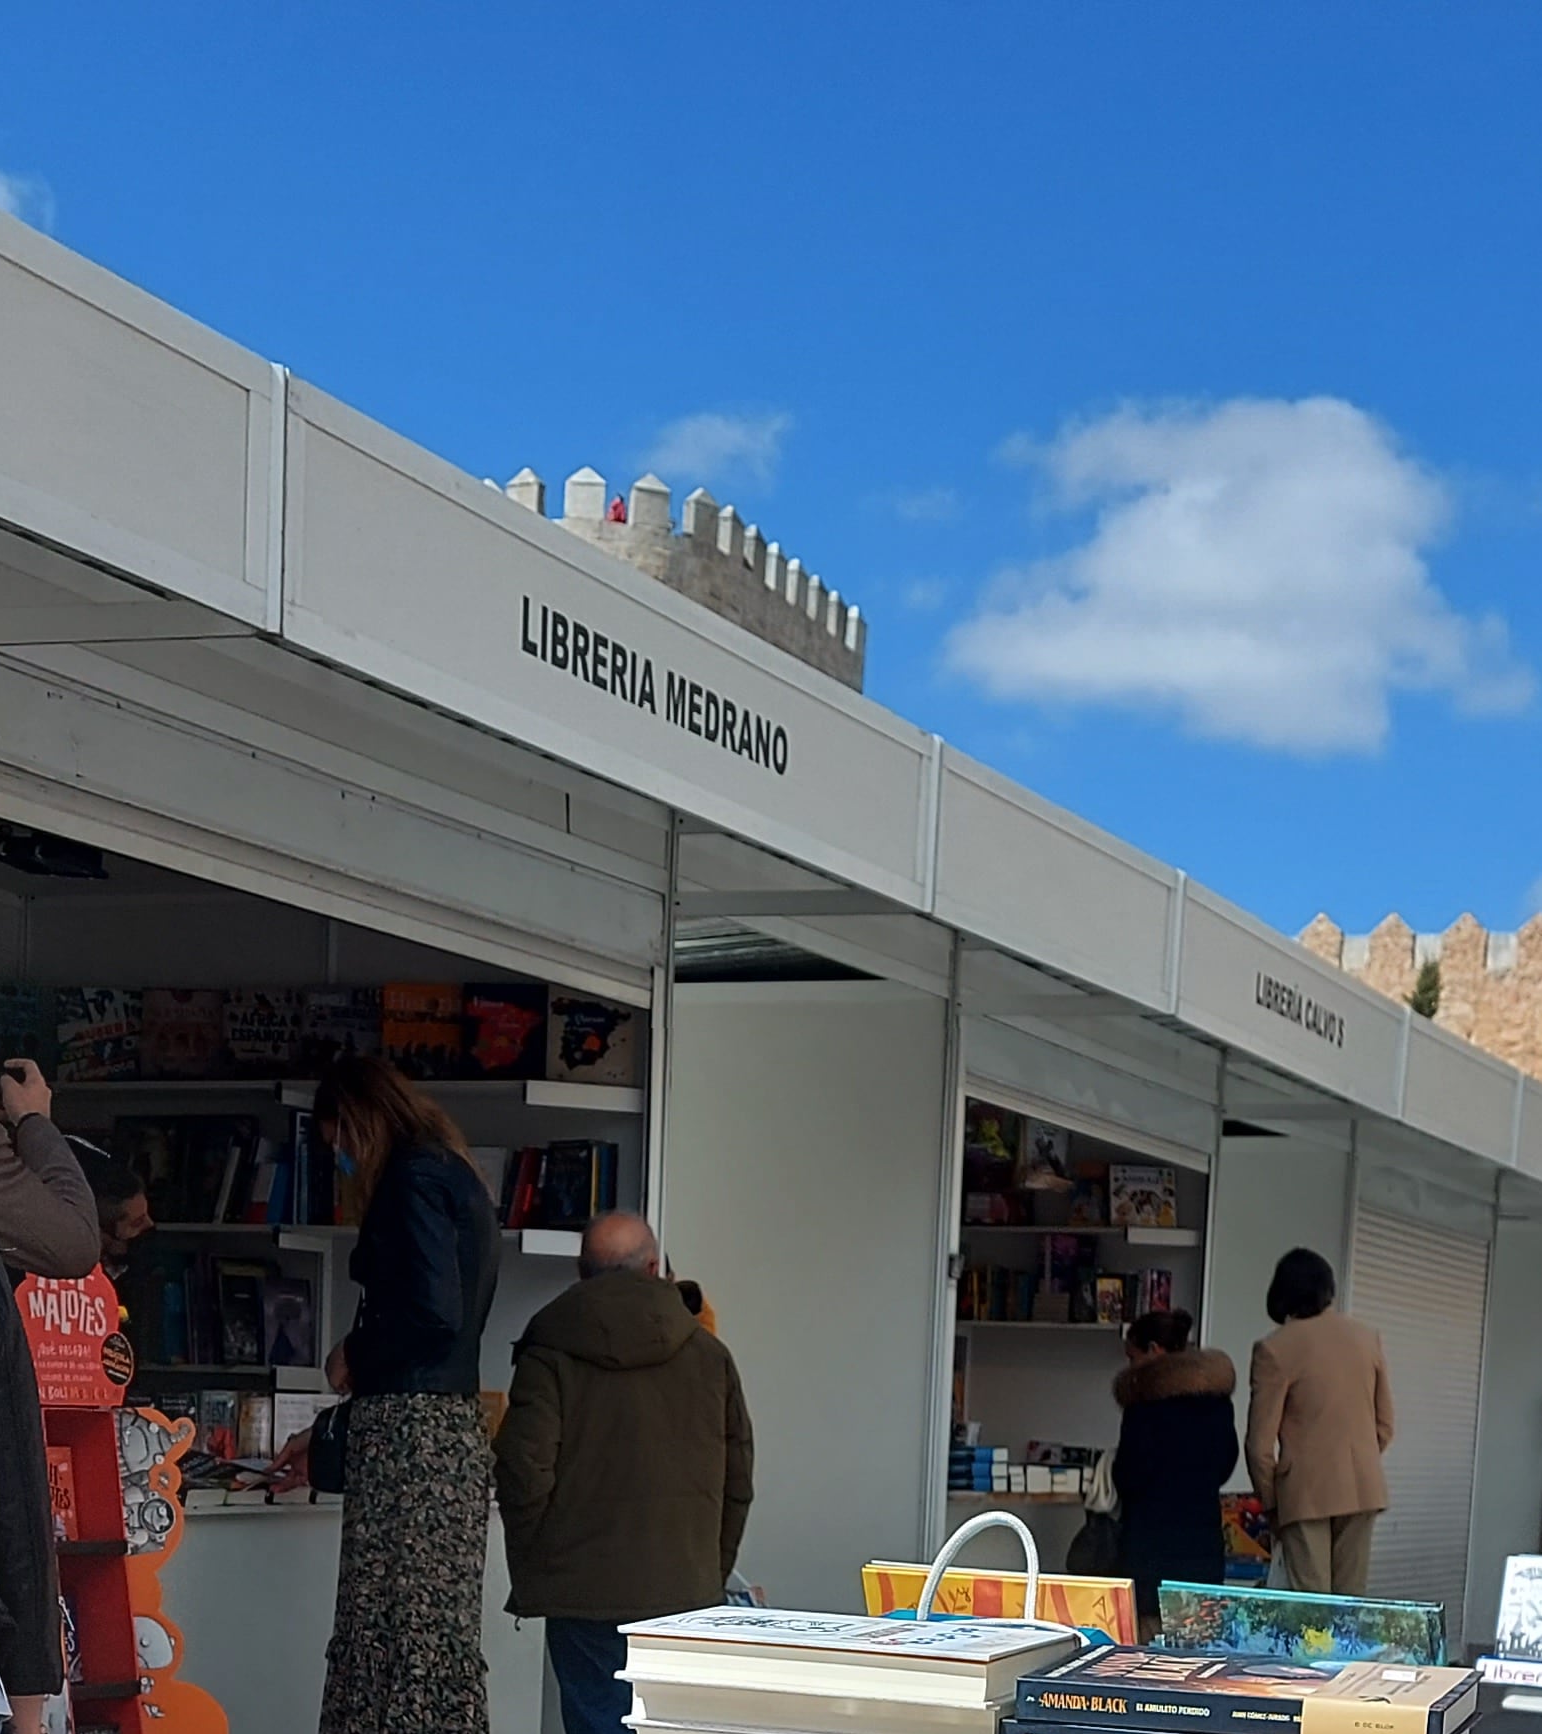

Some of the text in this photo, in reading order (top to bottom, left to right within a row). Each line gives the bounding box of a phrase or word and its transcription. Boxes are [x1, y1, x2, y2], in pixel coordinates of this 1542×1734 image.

[521, 595, 788, 775] LIBRERIA MEDRANO
[27, 1289, 107, 1336] MALOTES
[1039, 1689, 1210, 1717] AMANDA BLACK EL AMULETO PERDIDO
